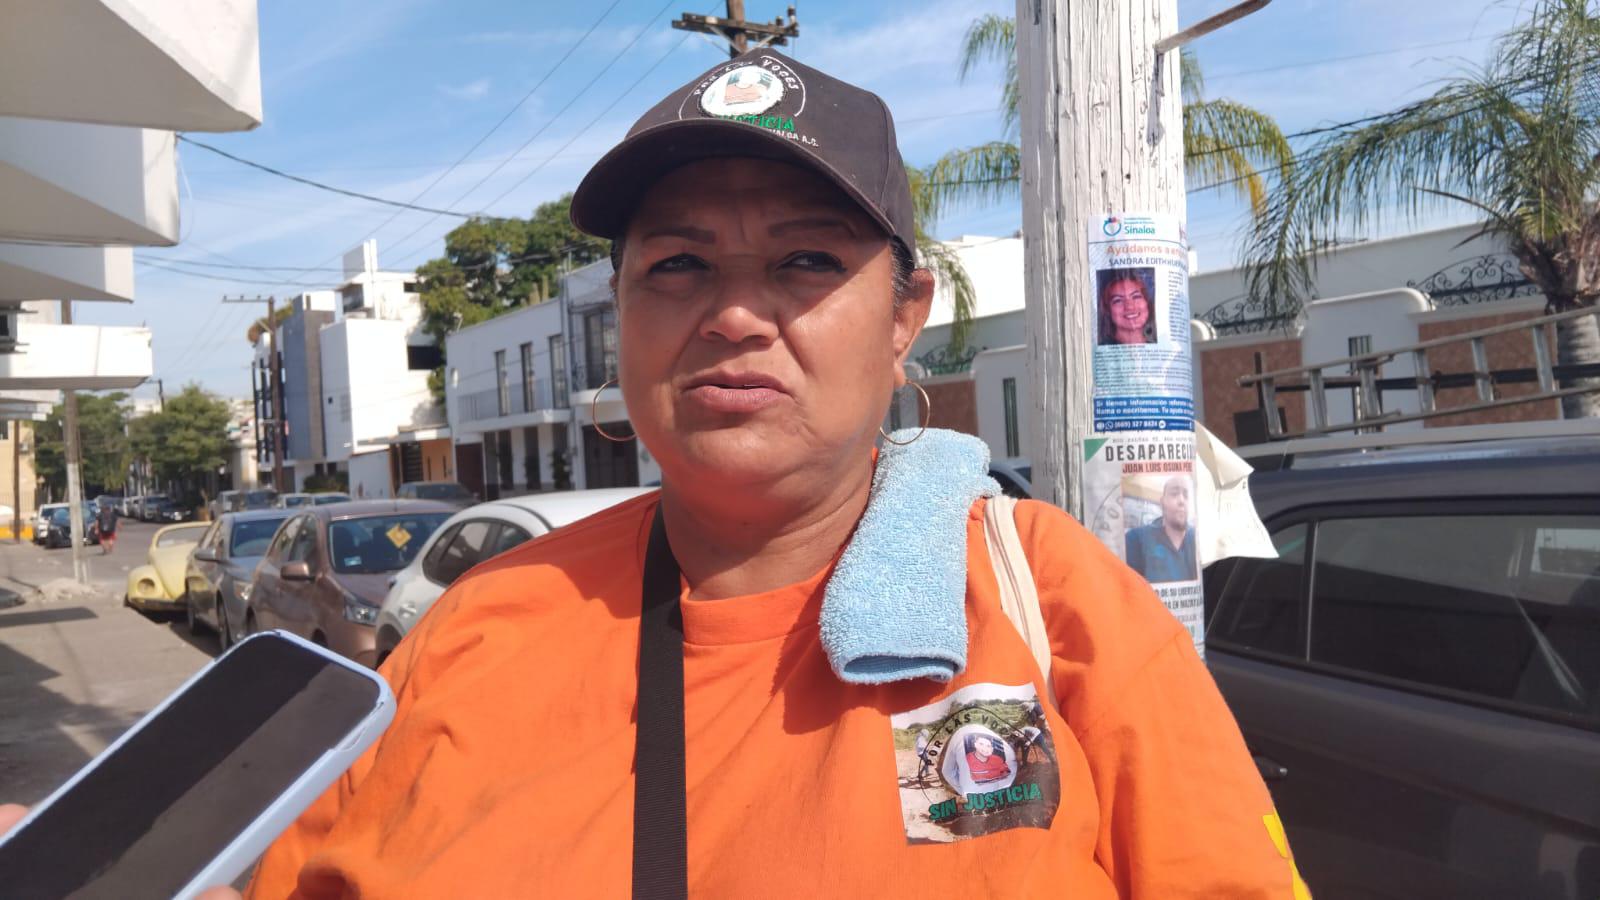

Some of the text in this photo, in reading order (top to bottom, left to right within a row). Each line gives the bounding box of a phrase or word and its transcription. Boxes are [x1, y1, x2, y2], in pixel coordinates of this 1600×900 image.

[761, 59, 799, 90] VOCES
[1124, 225, 1156, 235] Sinaloa
[1109, 257, 1144, 267] SANDRA
[1122, 463, 1144, 474] JUAN
[1145, 462, 1161, 473] LUIS
[927, 739, 943, 767] POR
[945, 713, 972, 735] LAS
[928, 783, 1042, 822] SIN JUSTICIA
